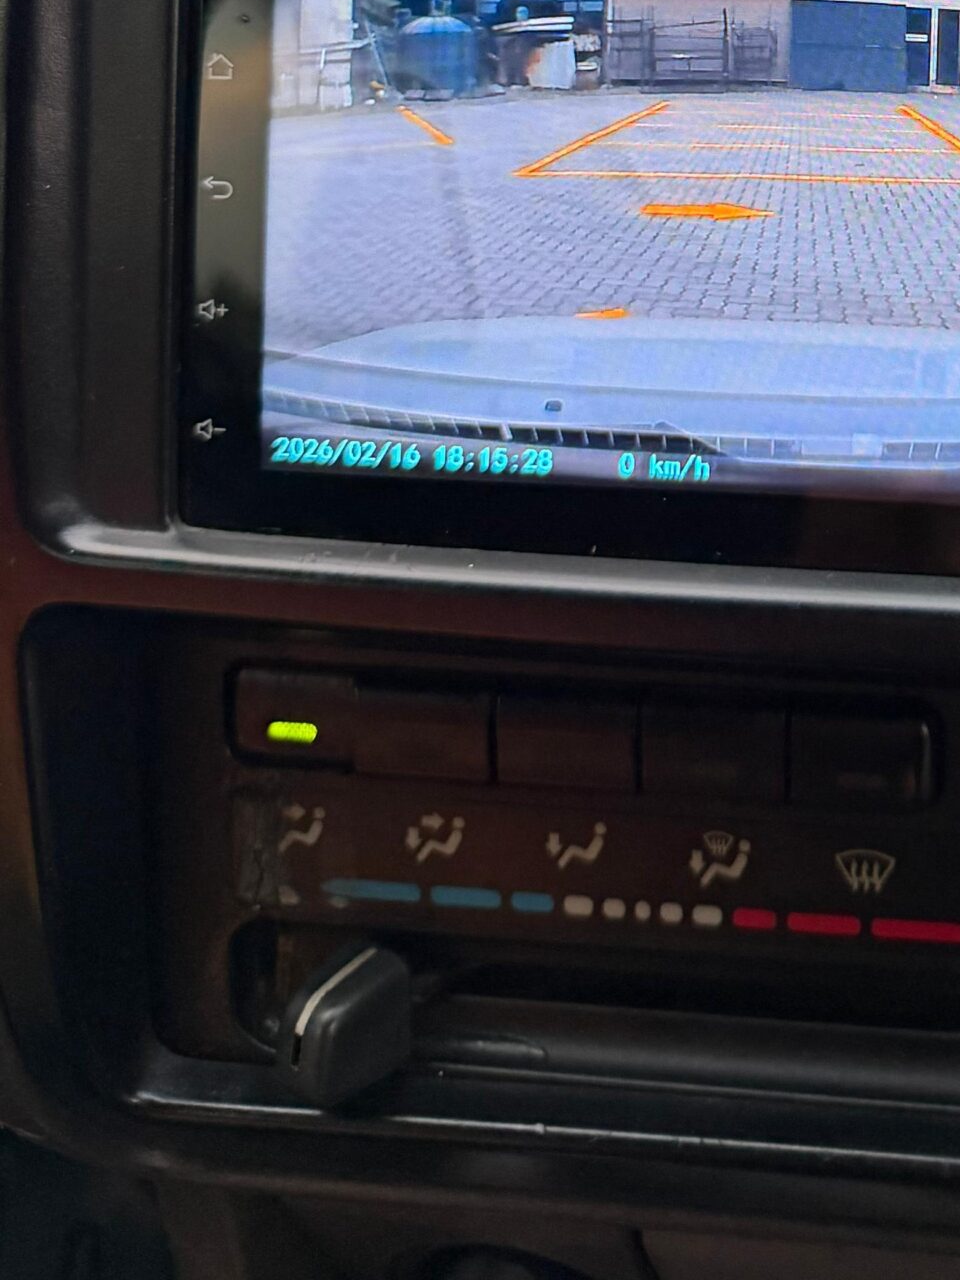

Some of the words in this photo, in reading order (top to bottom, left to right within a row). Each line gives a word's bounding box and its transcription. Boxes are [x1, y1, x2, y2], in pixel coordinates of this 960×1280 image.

[271, 436, 421, 471] 2026/02/16
[432, 444, 554, 477] 18:15:28
[618, 452, 636, 480] 0
[648, 453, 711, 481] km/h
